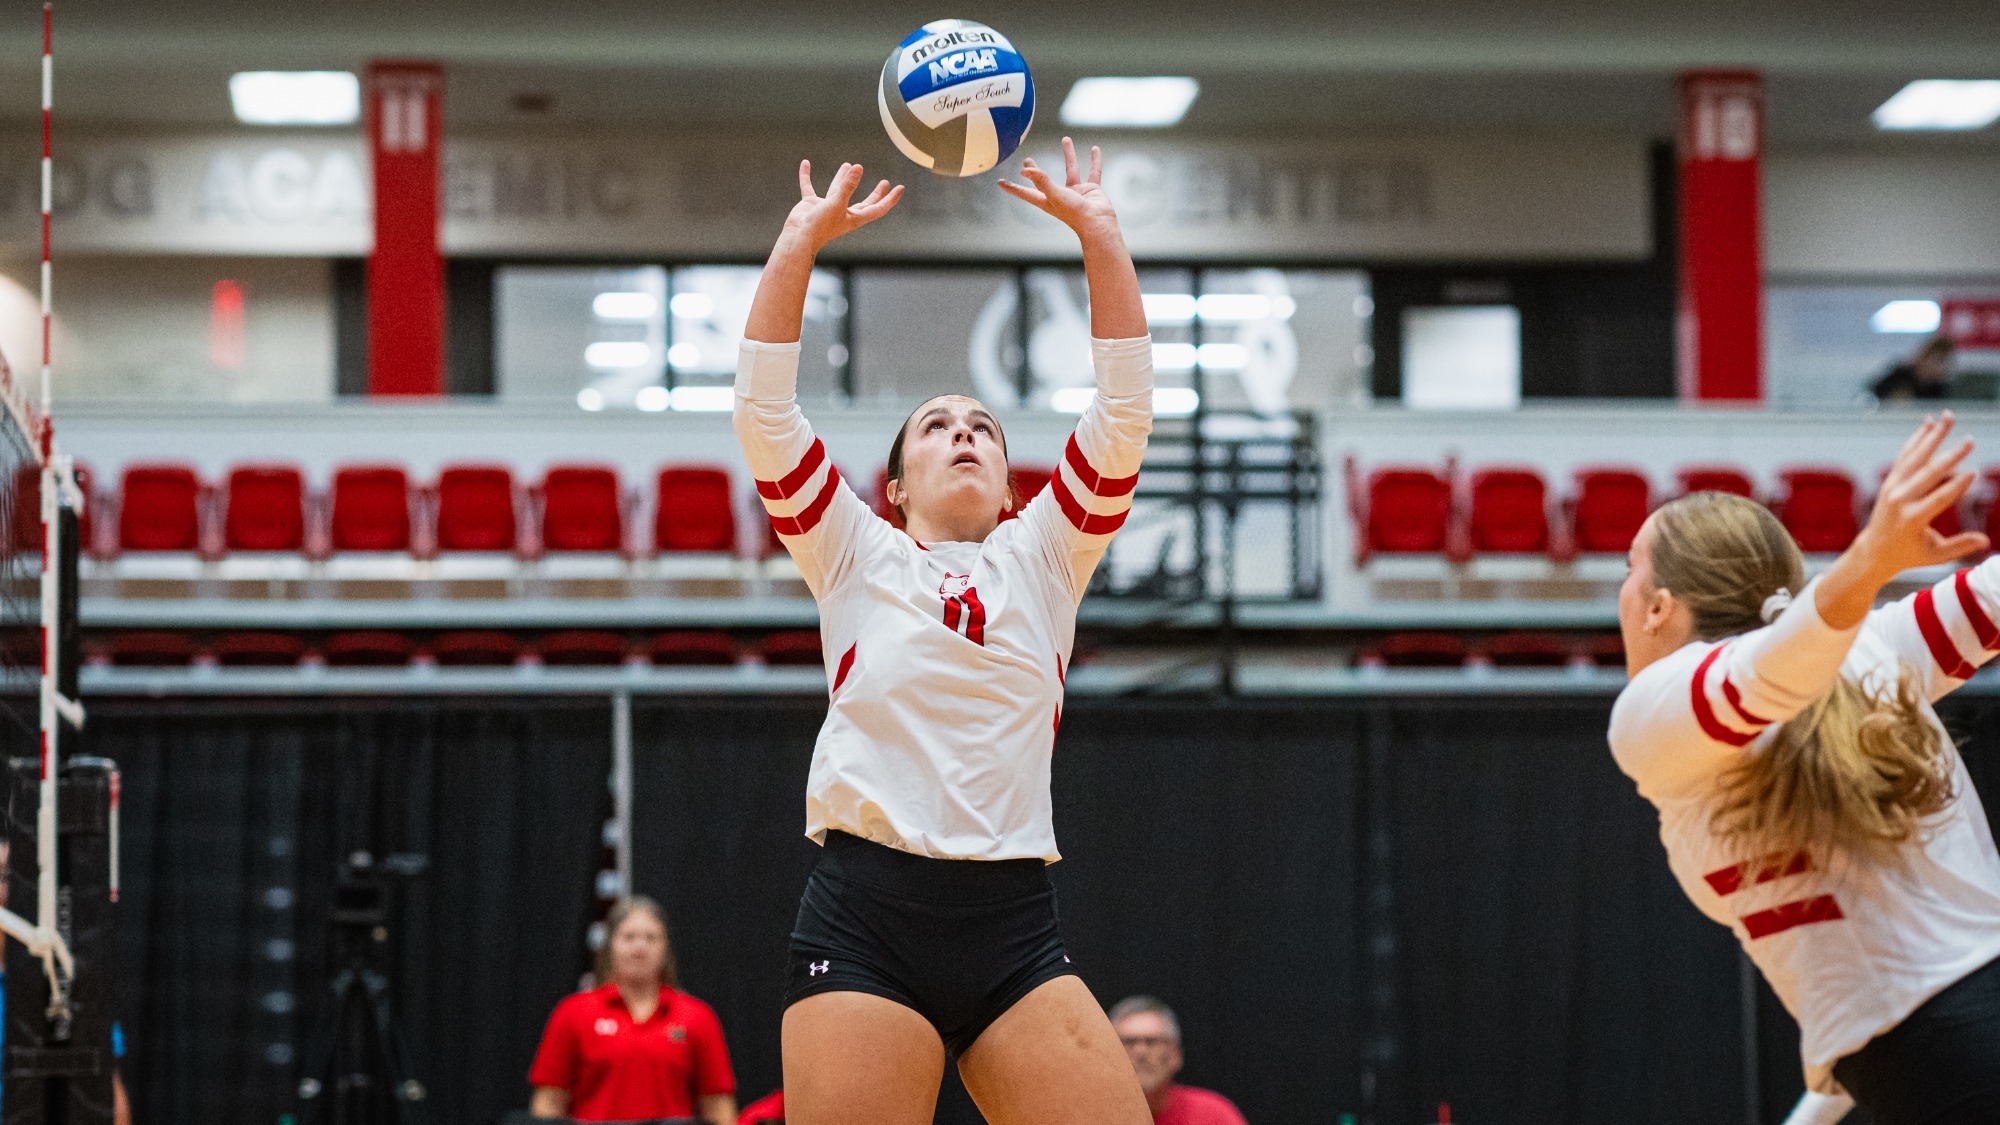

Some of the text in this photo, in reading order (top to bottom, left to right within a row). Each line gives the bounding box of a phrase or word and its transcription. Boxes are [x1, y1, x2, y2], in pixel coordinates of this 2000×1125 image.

[911, 31, 996, 63] molten
[928, 48, 999, 84] NCAA
[933, 80, 1011, 113] Super Touch
[195, 148, 642, 222] ACAEMIC
